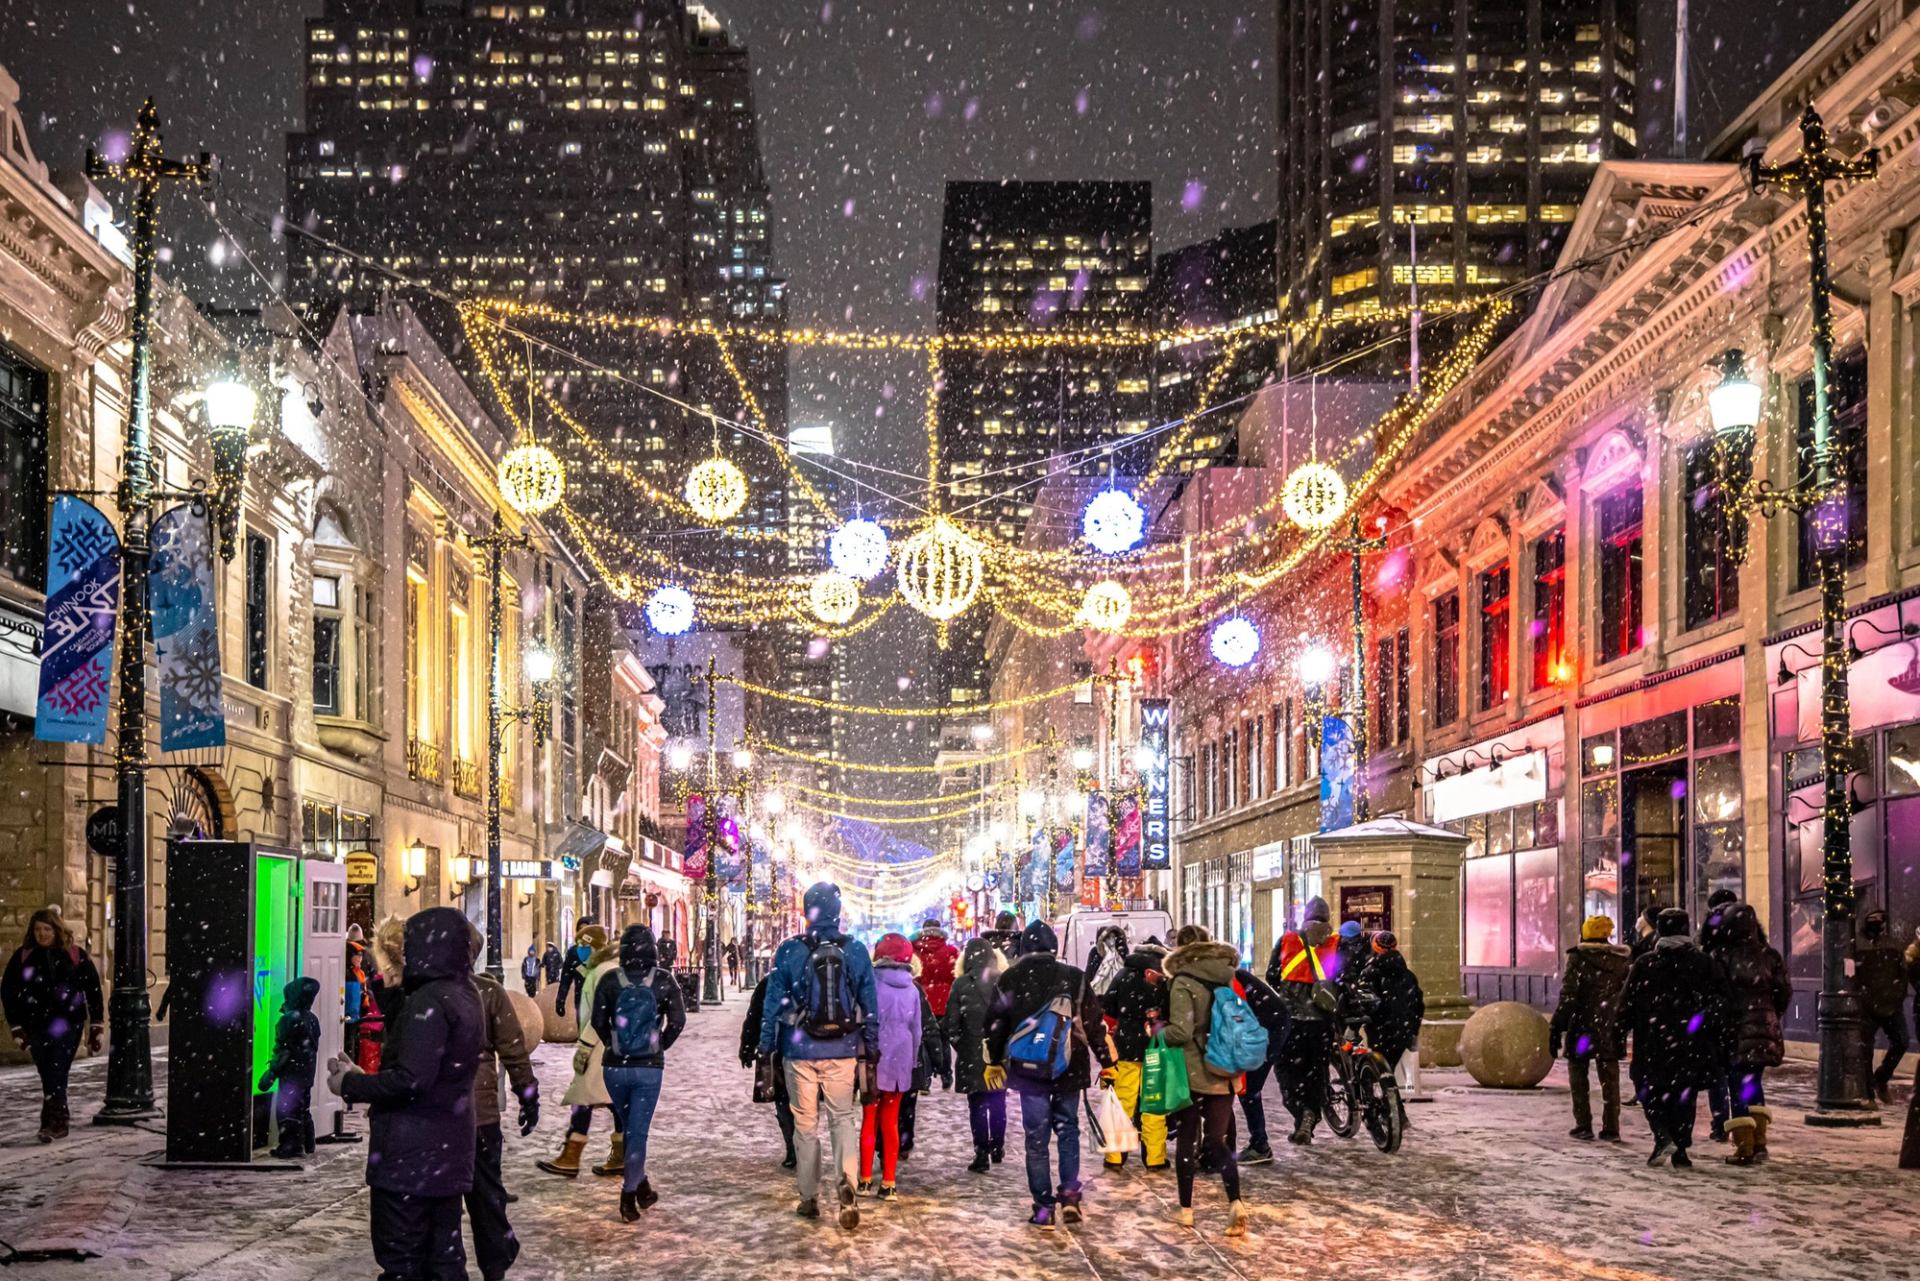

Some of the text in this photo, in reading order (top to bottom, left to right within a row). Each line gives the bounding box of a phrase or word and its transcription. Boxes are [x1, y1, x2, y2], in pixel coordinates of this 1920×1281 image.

[41, 573, 120, 659] BLAST
[48, 577, 101, 622] CHINOOK
[1143, 709, 1169, 859] WINNERS
